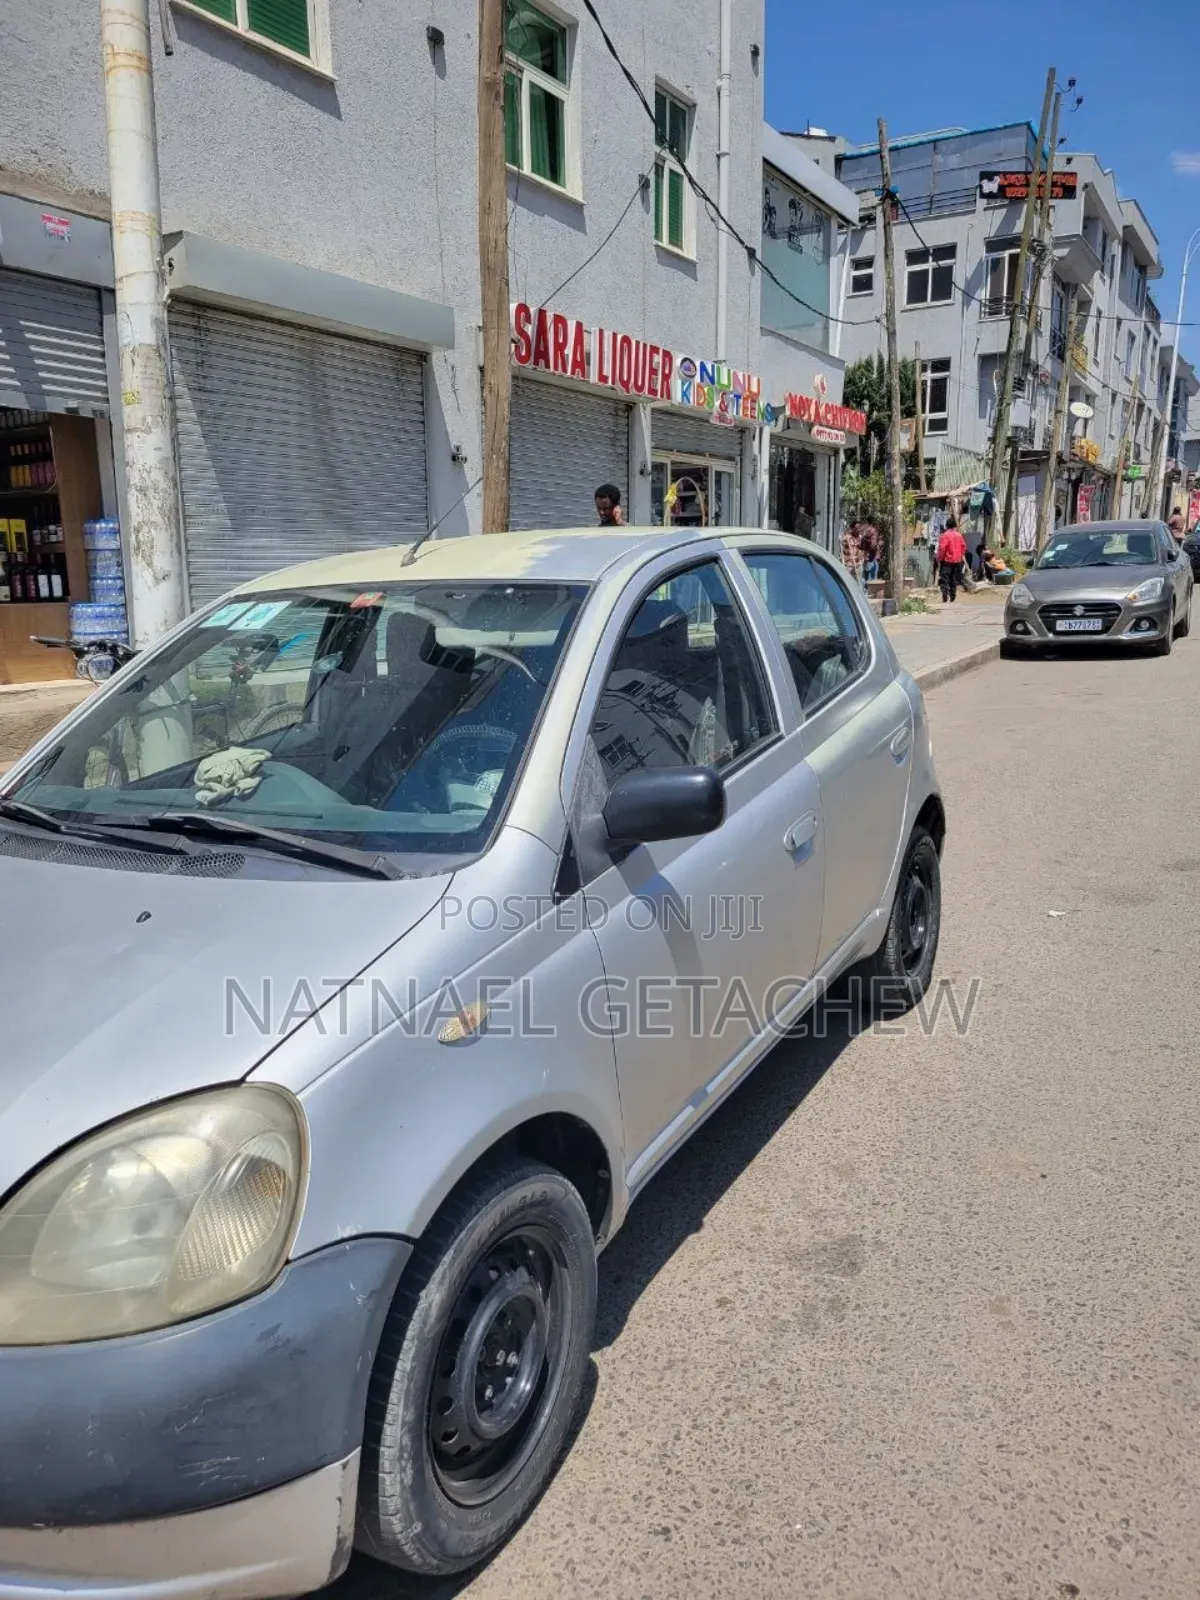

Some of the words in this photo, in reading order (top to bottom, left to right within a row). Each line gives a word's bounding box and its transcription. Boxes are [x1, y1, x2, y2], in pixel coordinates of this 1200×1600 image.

[514, 303, 586, 379] SARA
[598, 328, 673, 400] LIQUER
[700, 361, 760, 398] NUNU
[733, 394, 774, 424] TEENS
